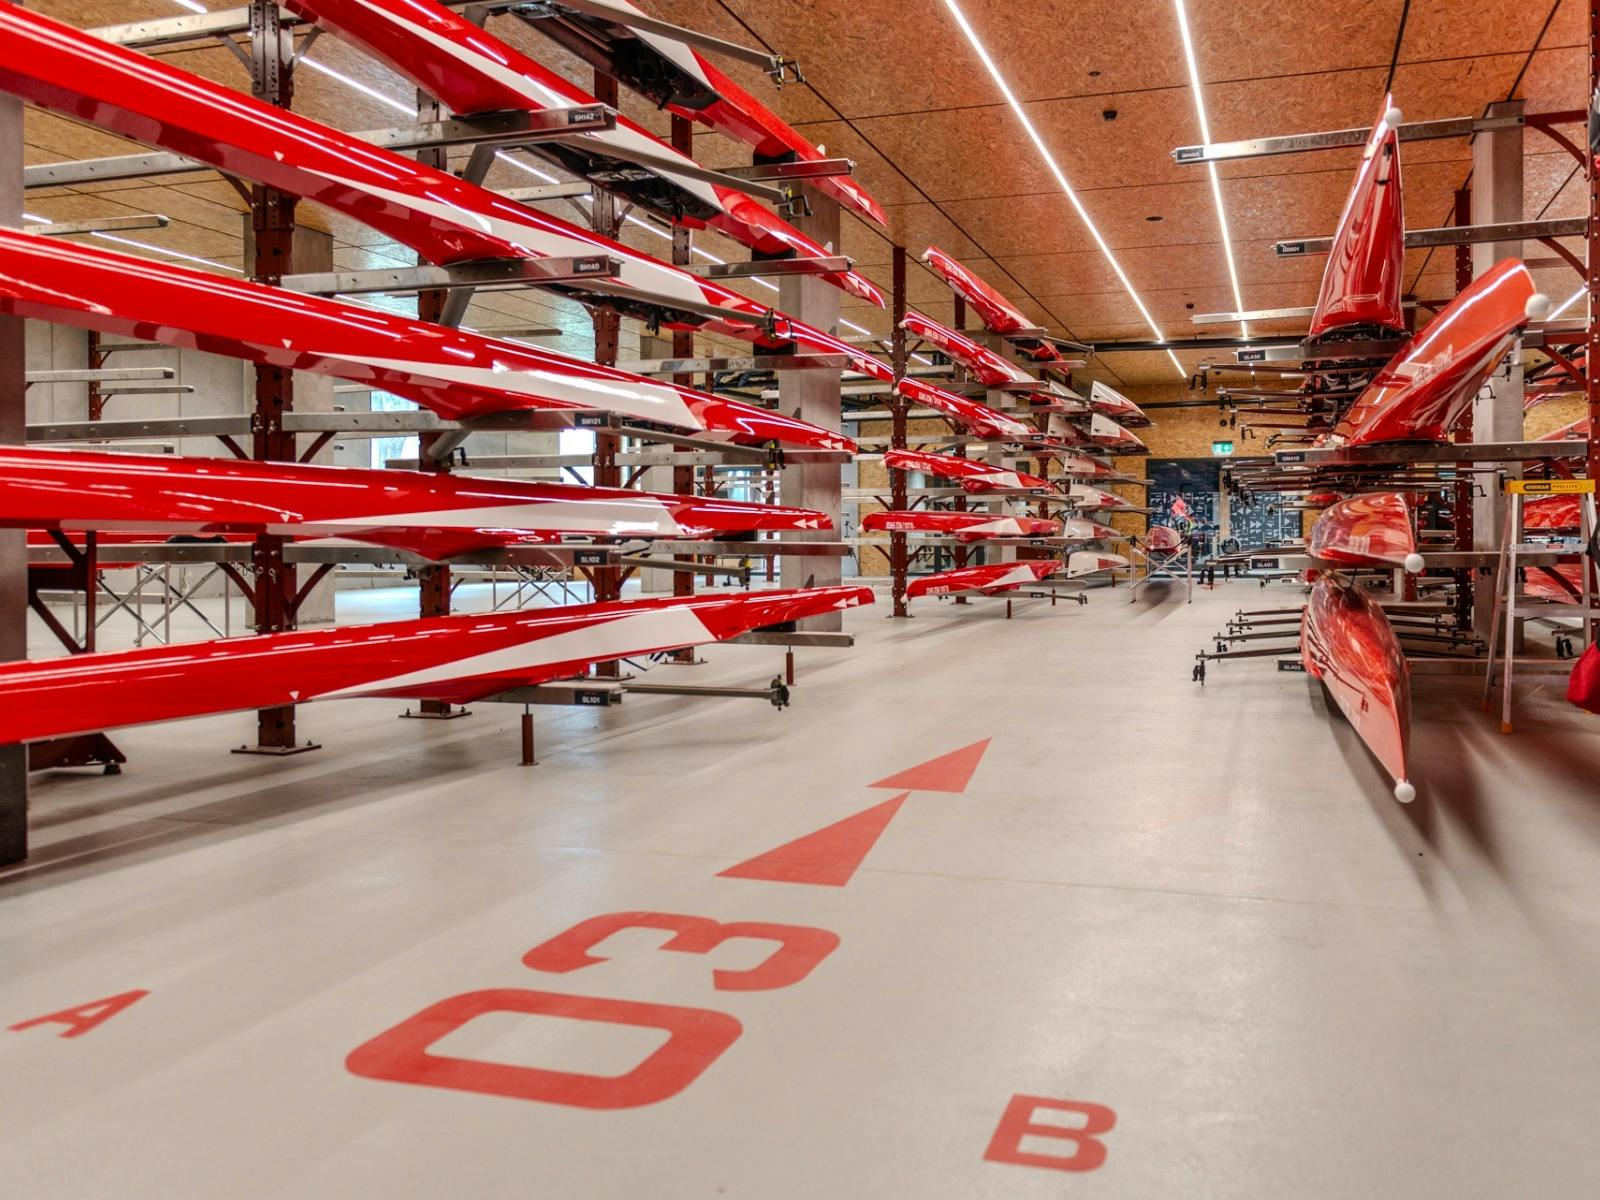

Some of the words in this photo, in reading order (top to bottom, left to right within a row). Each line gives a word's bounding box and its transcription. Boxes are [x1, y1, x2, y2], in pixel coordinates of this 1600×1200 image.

[579, 263, 600, 271] SH140
[581, 417, 601, 425] SM121
[9, 989, 149, 1039] A
[345, 911, 840, 1110] 03
[984, 1094, 1117, 1171] B
